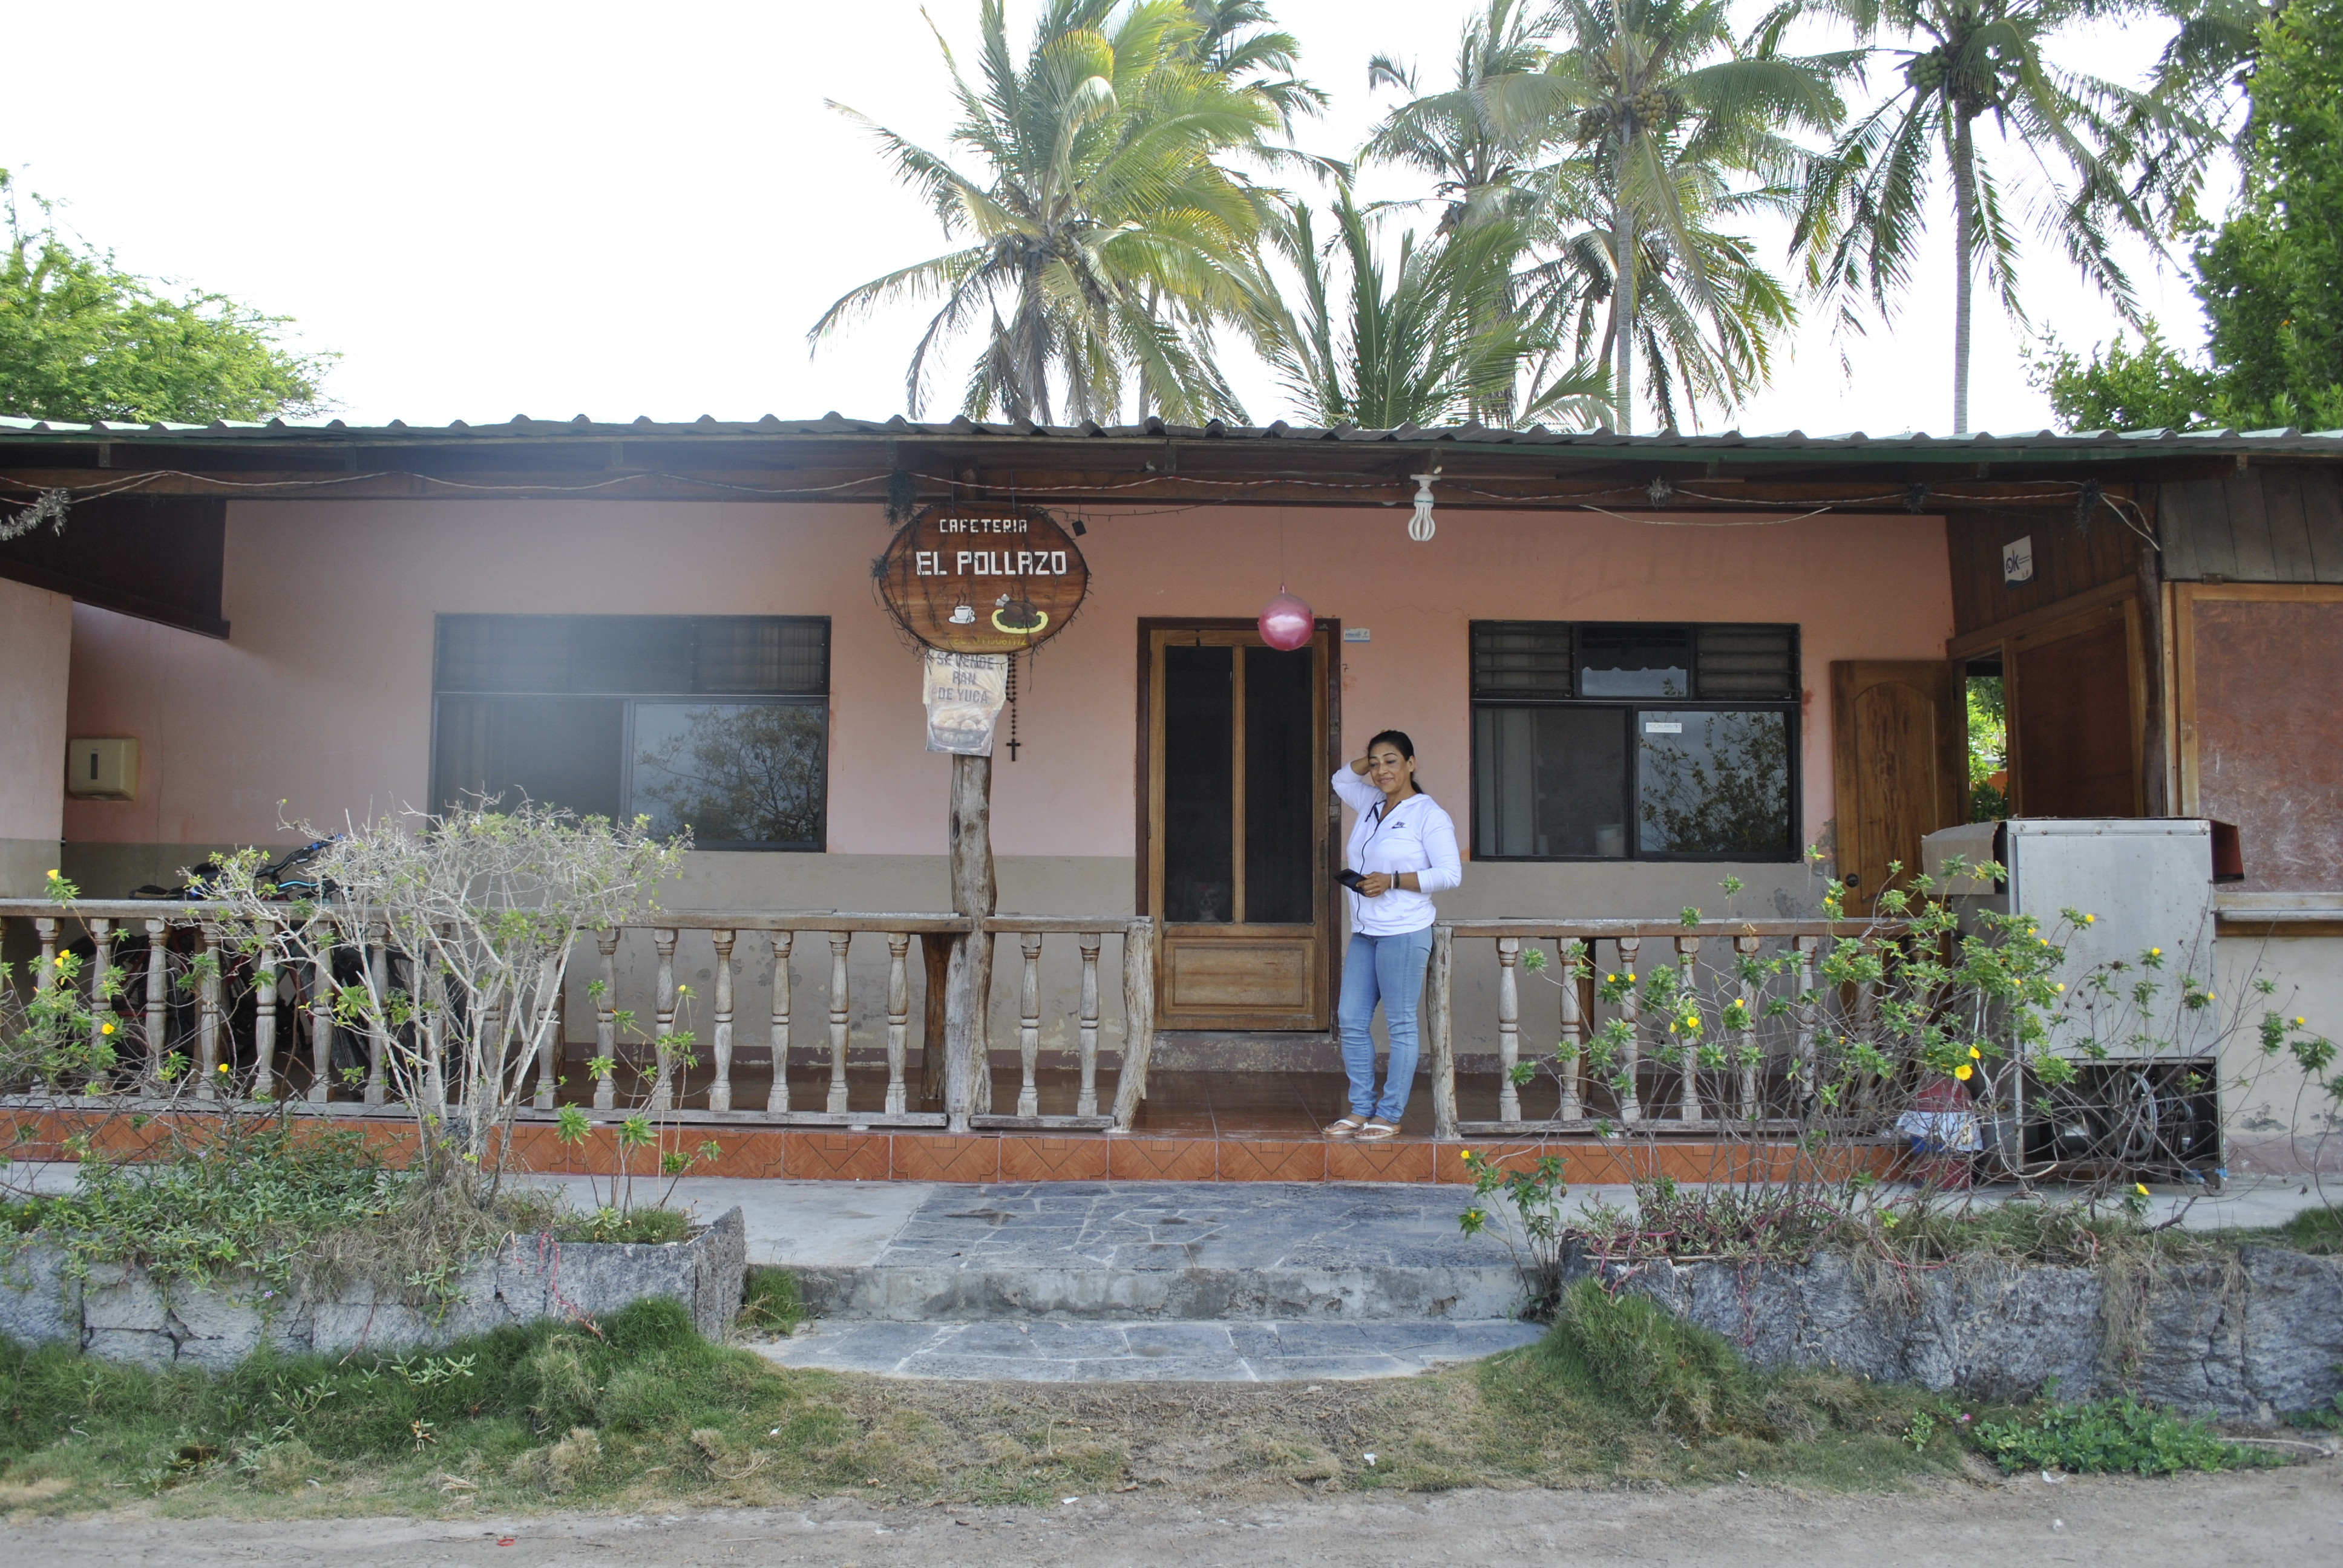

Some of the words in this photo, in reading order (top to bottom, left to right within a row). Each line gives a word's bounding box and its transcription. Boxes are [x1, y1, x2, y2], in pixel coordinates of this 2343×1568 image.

[940, 519, 1027, 533] CAFETERIA
[916, 551, 947, 575] EL
[957, 551, 1066, 575] POLLAZO
[952, 671, 976, 685] PAN
[938, 687, 953, 701] DE
[957, 689, 988, 704] YUCA
